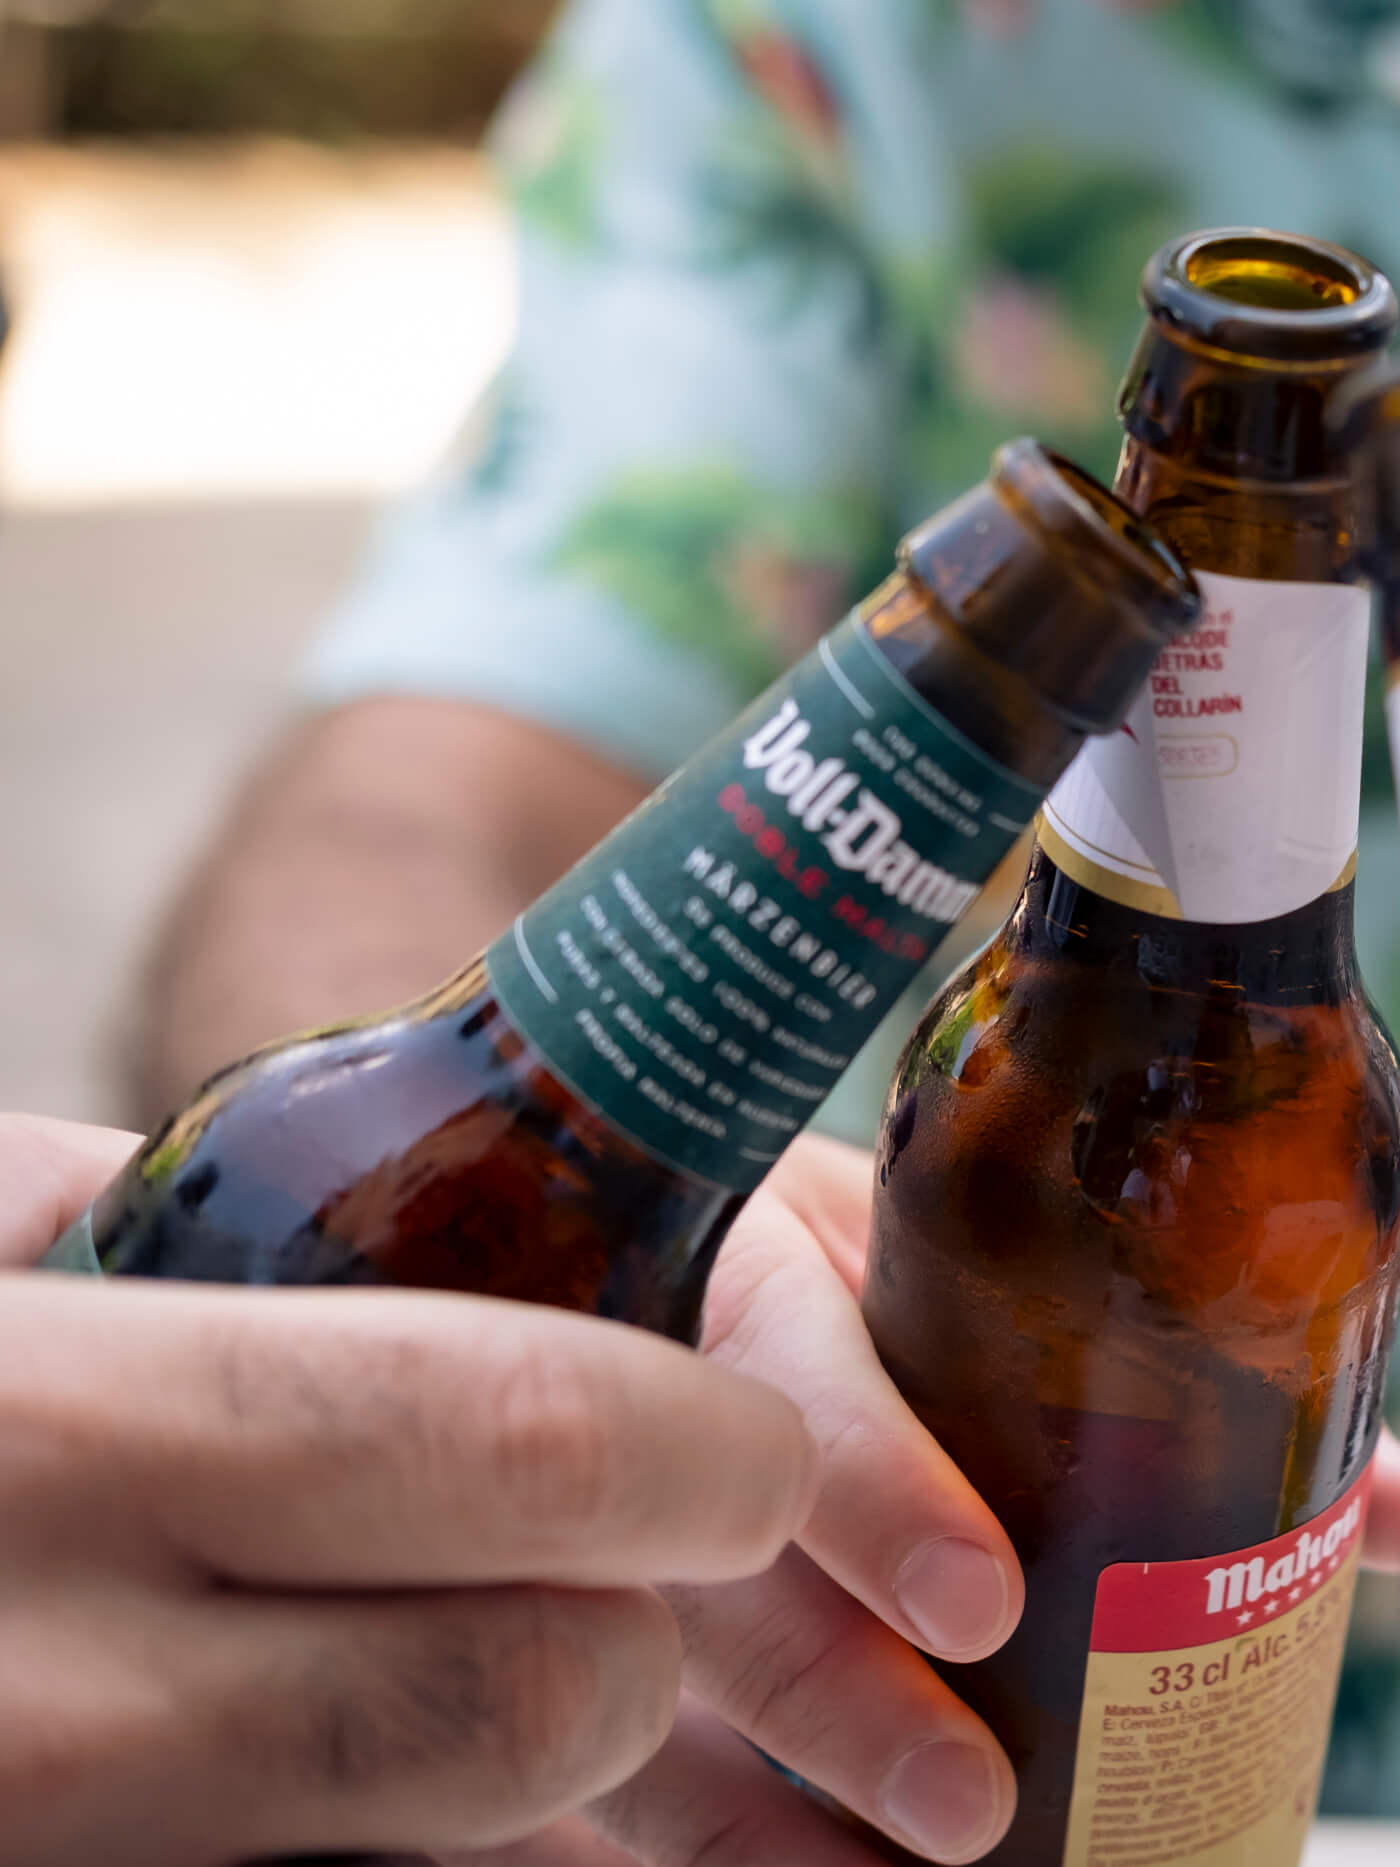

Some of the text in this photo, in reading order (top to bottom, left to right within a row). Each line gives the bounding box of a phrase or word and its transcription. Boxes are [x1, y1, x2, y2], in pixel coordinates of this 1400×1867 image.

[1150, 676, 1183, 695] DEL
[1153, 693, 1242, 718] COLLARÍN
[717, 780, 829, 899] DOBLE
[708, 921, 798, 1000] PRODUCE
[792, 990, 835, 1024] CON
[712, 977, 775, 1033] 100%
[1204, 1495, 1362, 1616] Mahou
[1149, 1662, 1195, 1695] 33
[1202, 1652, 1231, 1686] cl
